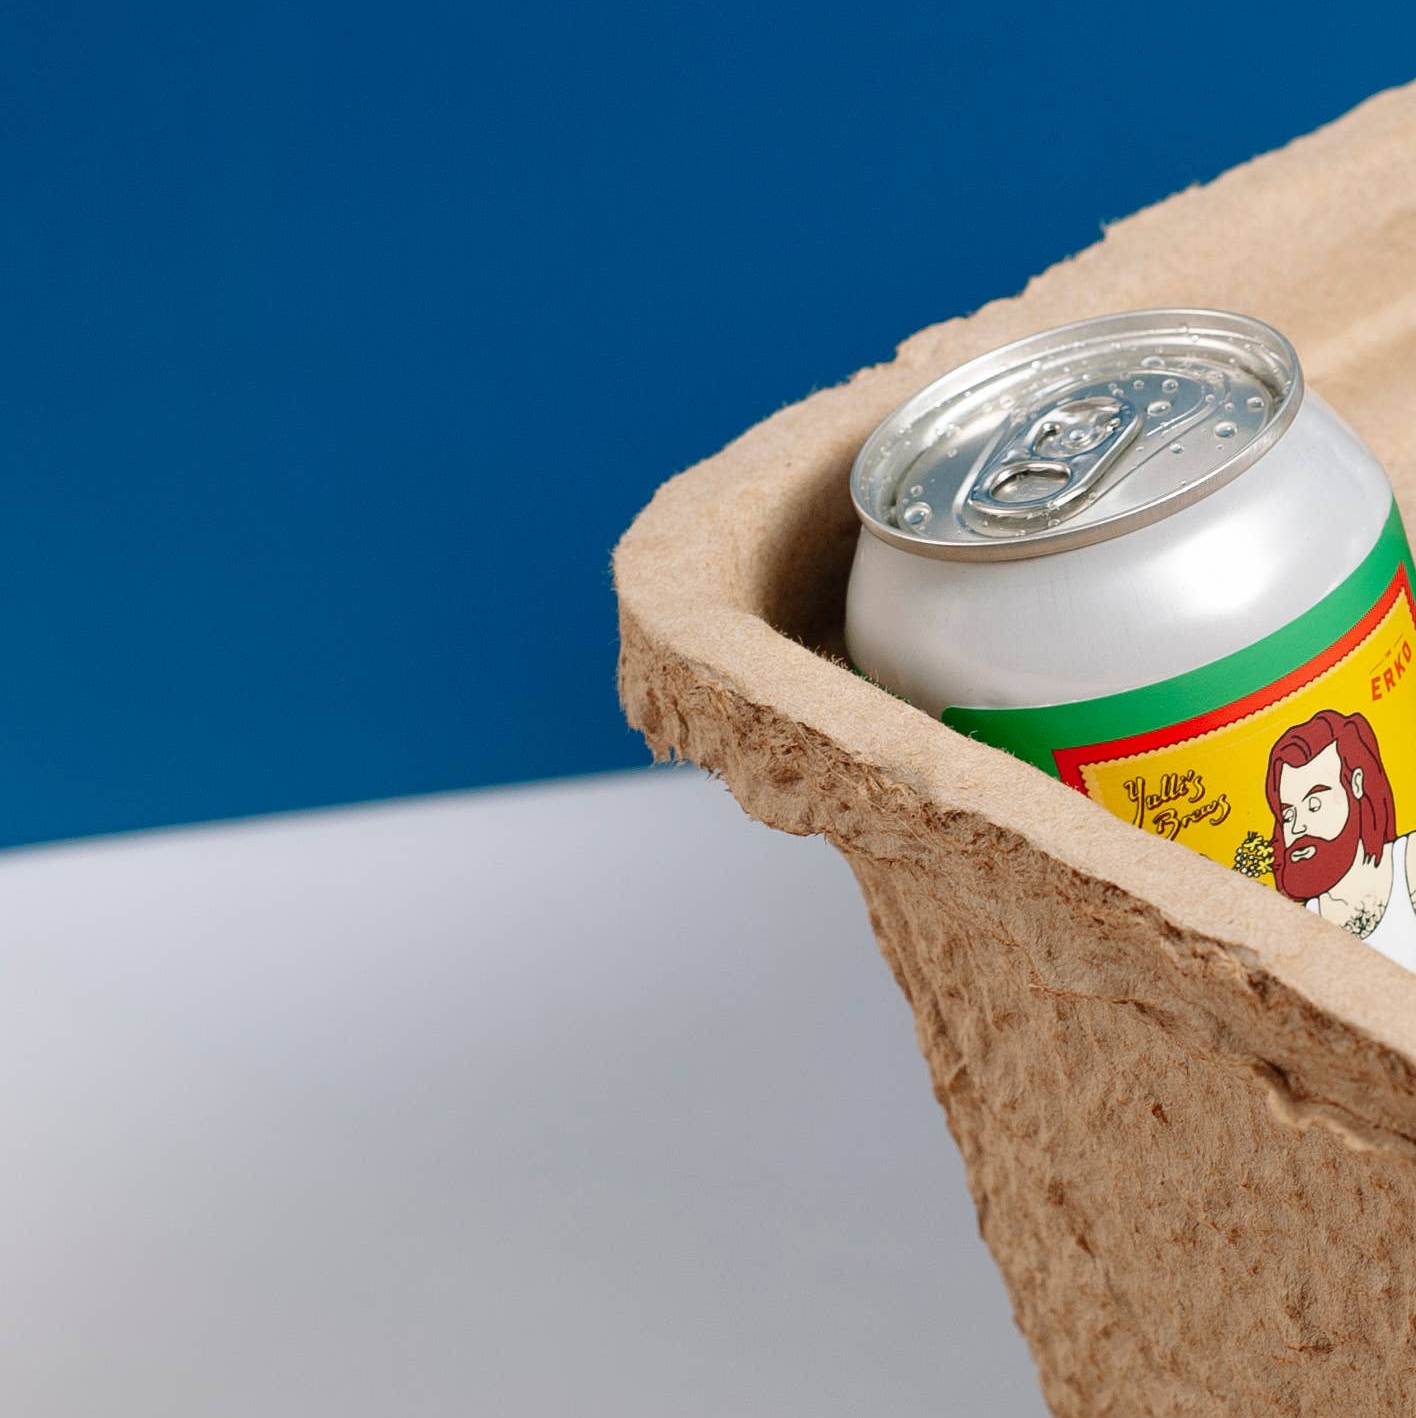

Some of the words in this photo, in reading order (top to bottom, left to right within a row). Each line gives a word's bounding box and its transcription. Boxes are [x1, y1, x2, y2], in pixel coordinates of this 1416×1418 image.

[1371, 641, 1411, 701] ERKO
[1123, 770, 1206, 829] Yulli's
[1152, 794, 1231, 841] Brews
